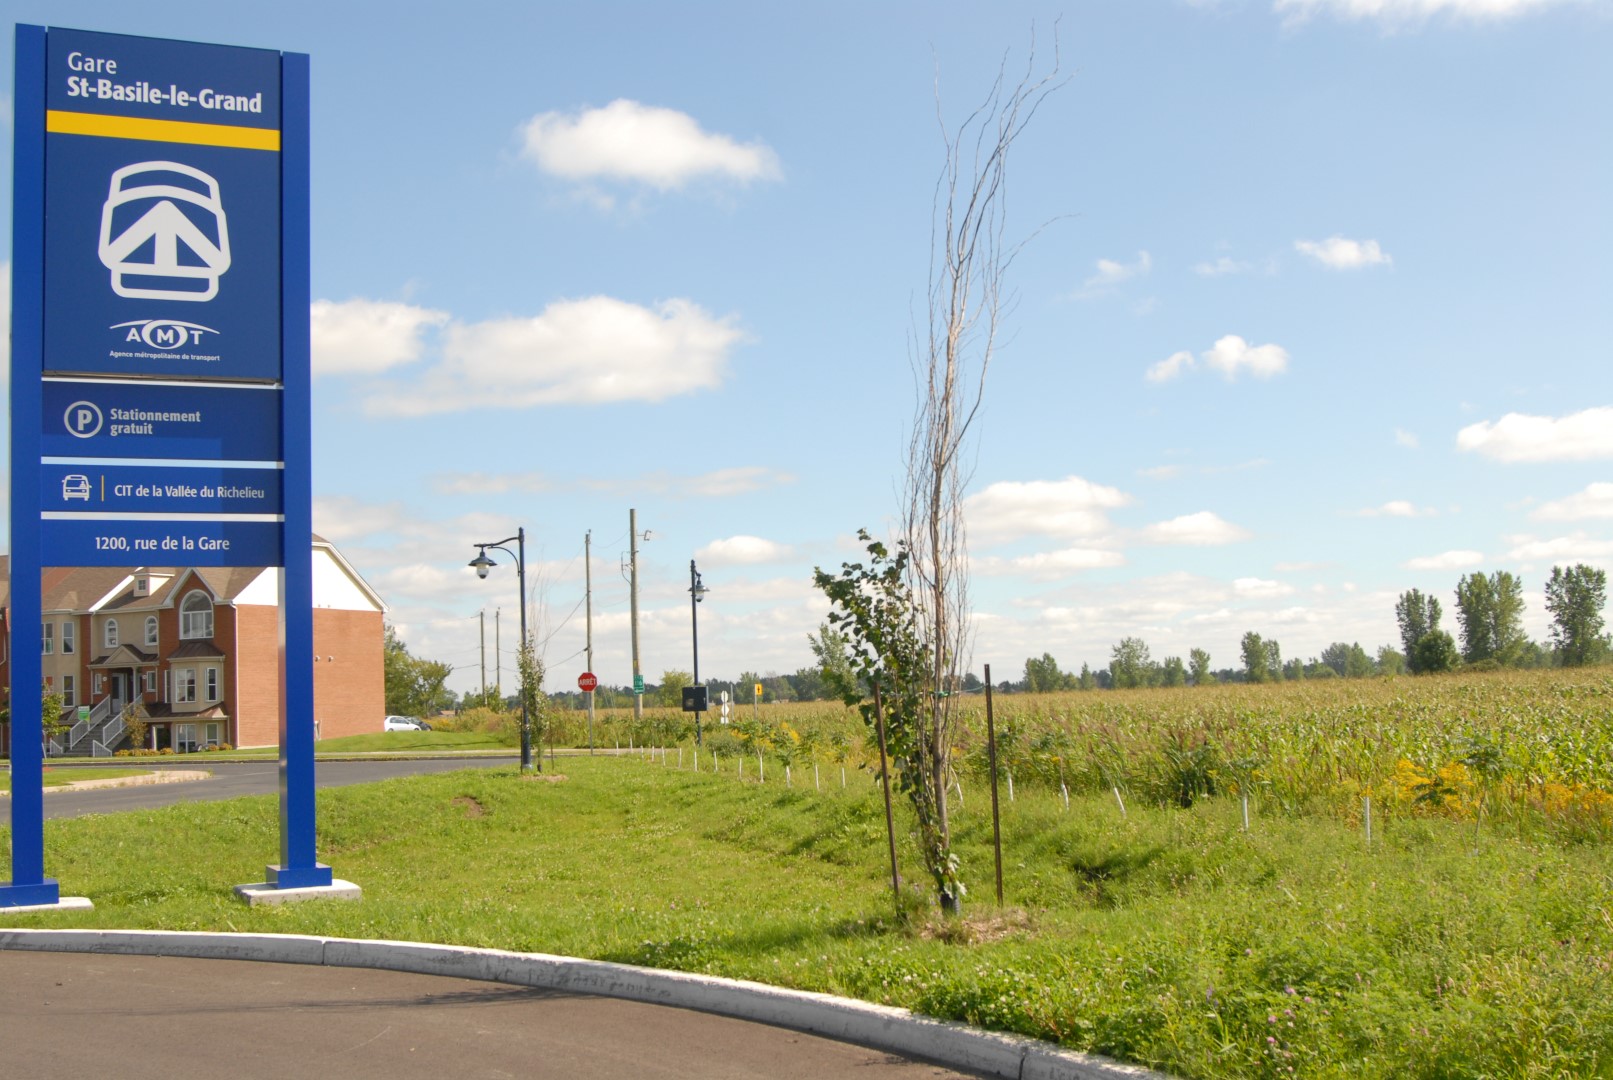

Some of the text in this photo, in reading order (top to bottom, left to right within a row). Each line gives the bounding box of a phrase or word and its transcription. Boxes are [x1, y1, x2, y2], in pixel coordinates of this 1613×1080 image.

[67, 52, 117, 75] Gare
[67, 75, 262, 113] St-Basile-le-Grand
[126, 327, 203, 345] AMT
[134, 352, 180, 360] métropolitaine
[191, 354, 220, 362] transport
[77, 409, 93, 431] P
[110, 408, 201, 422] Stationnement
[110, 422, 153, 436] gratuit
[114, 484, 265, 499] CIT de la Vallée du Richelieu
[95, 536, 230, 552] 1200, rue de la Gare
[578, 678, 596, 686] ARRÊT
